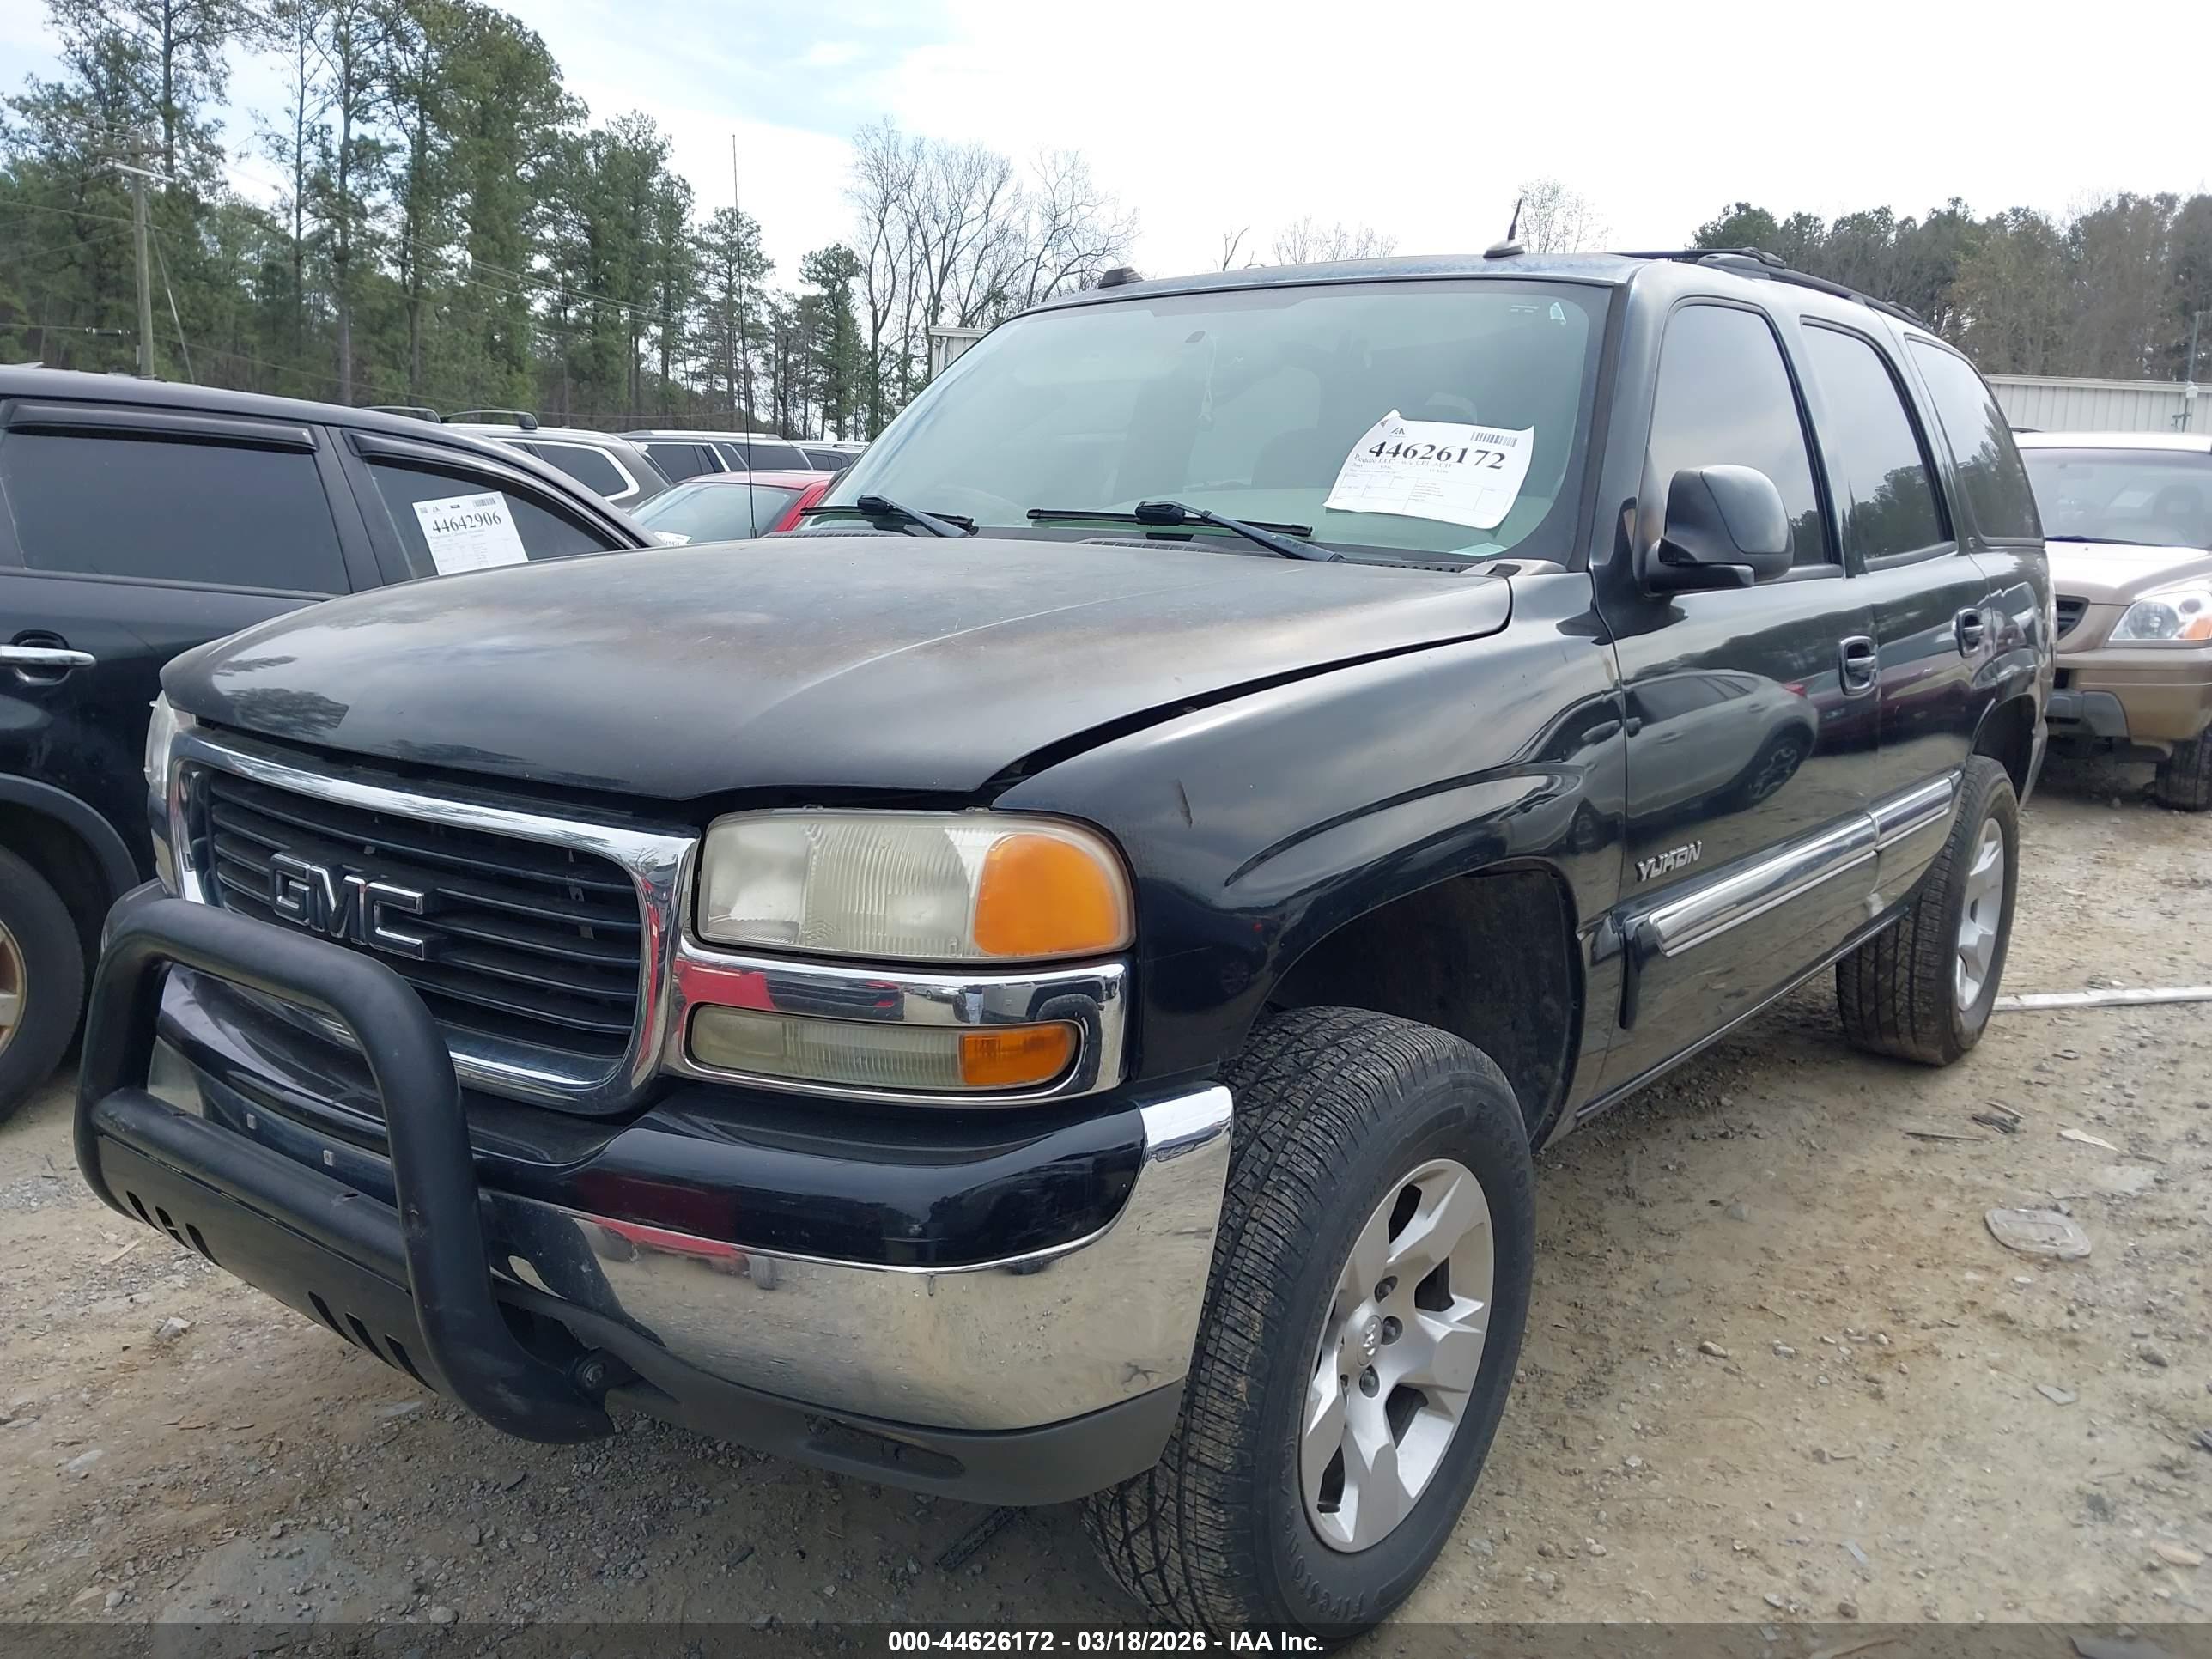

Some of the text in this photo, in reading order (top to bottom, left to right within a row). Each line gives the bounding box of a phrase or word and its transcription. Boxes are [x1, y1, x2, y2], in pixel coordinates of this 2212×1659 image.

[1369, 441, 1505, 470] 44626172
[432, 510, 501, 533] 44642906
[1635, 840, 1702, 882] YUKON
[270, 853, 425, 961] GMC
